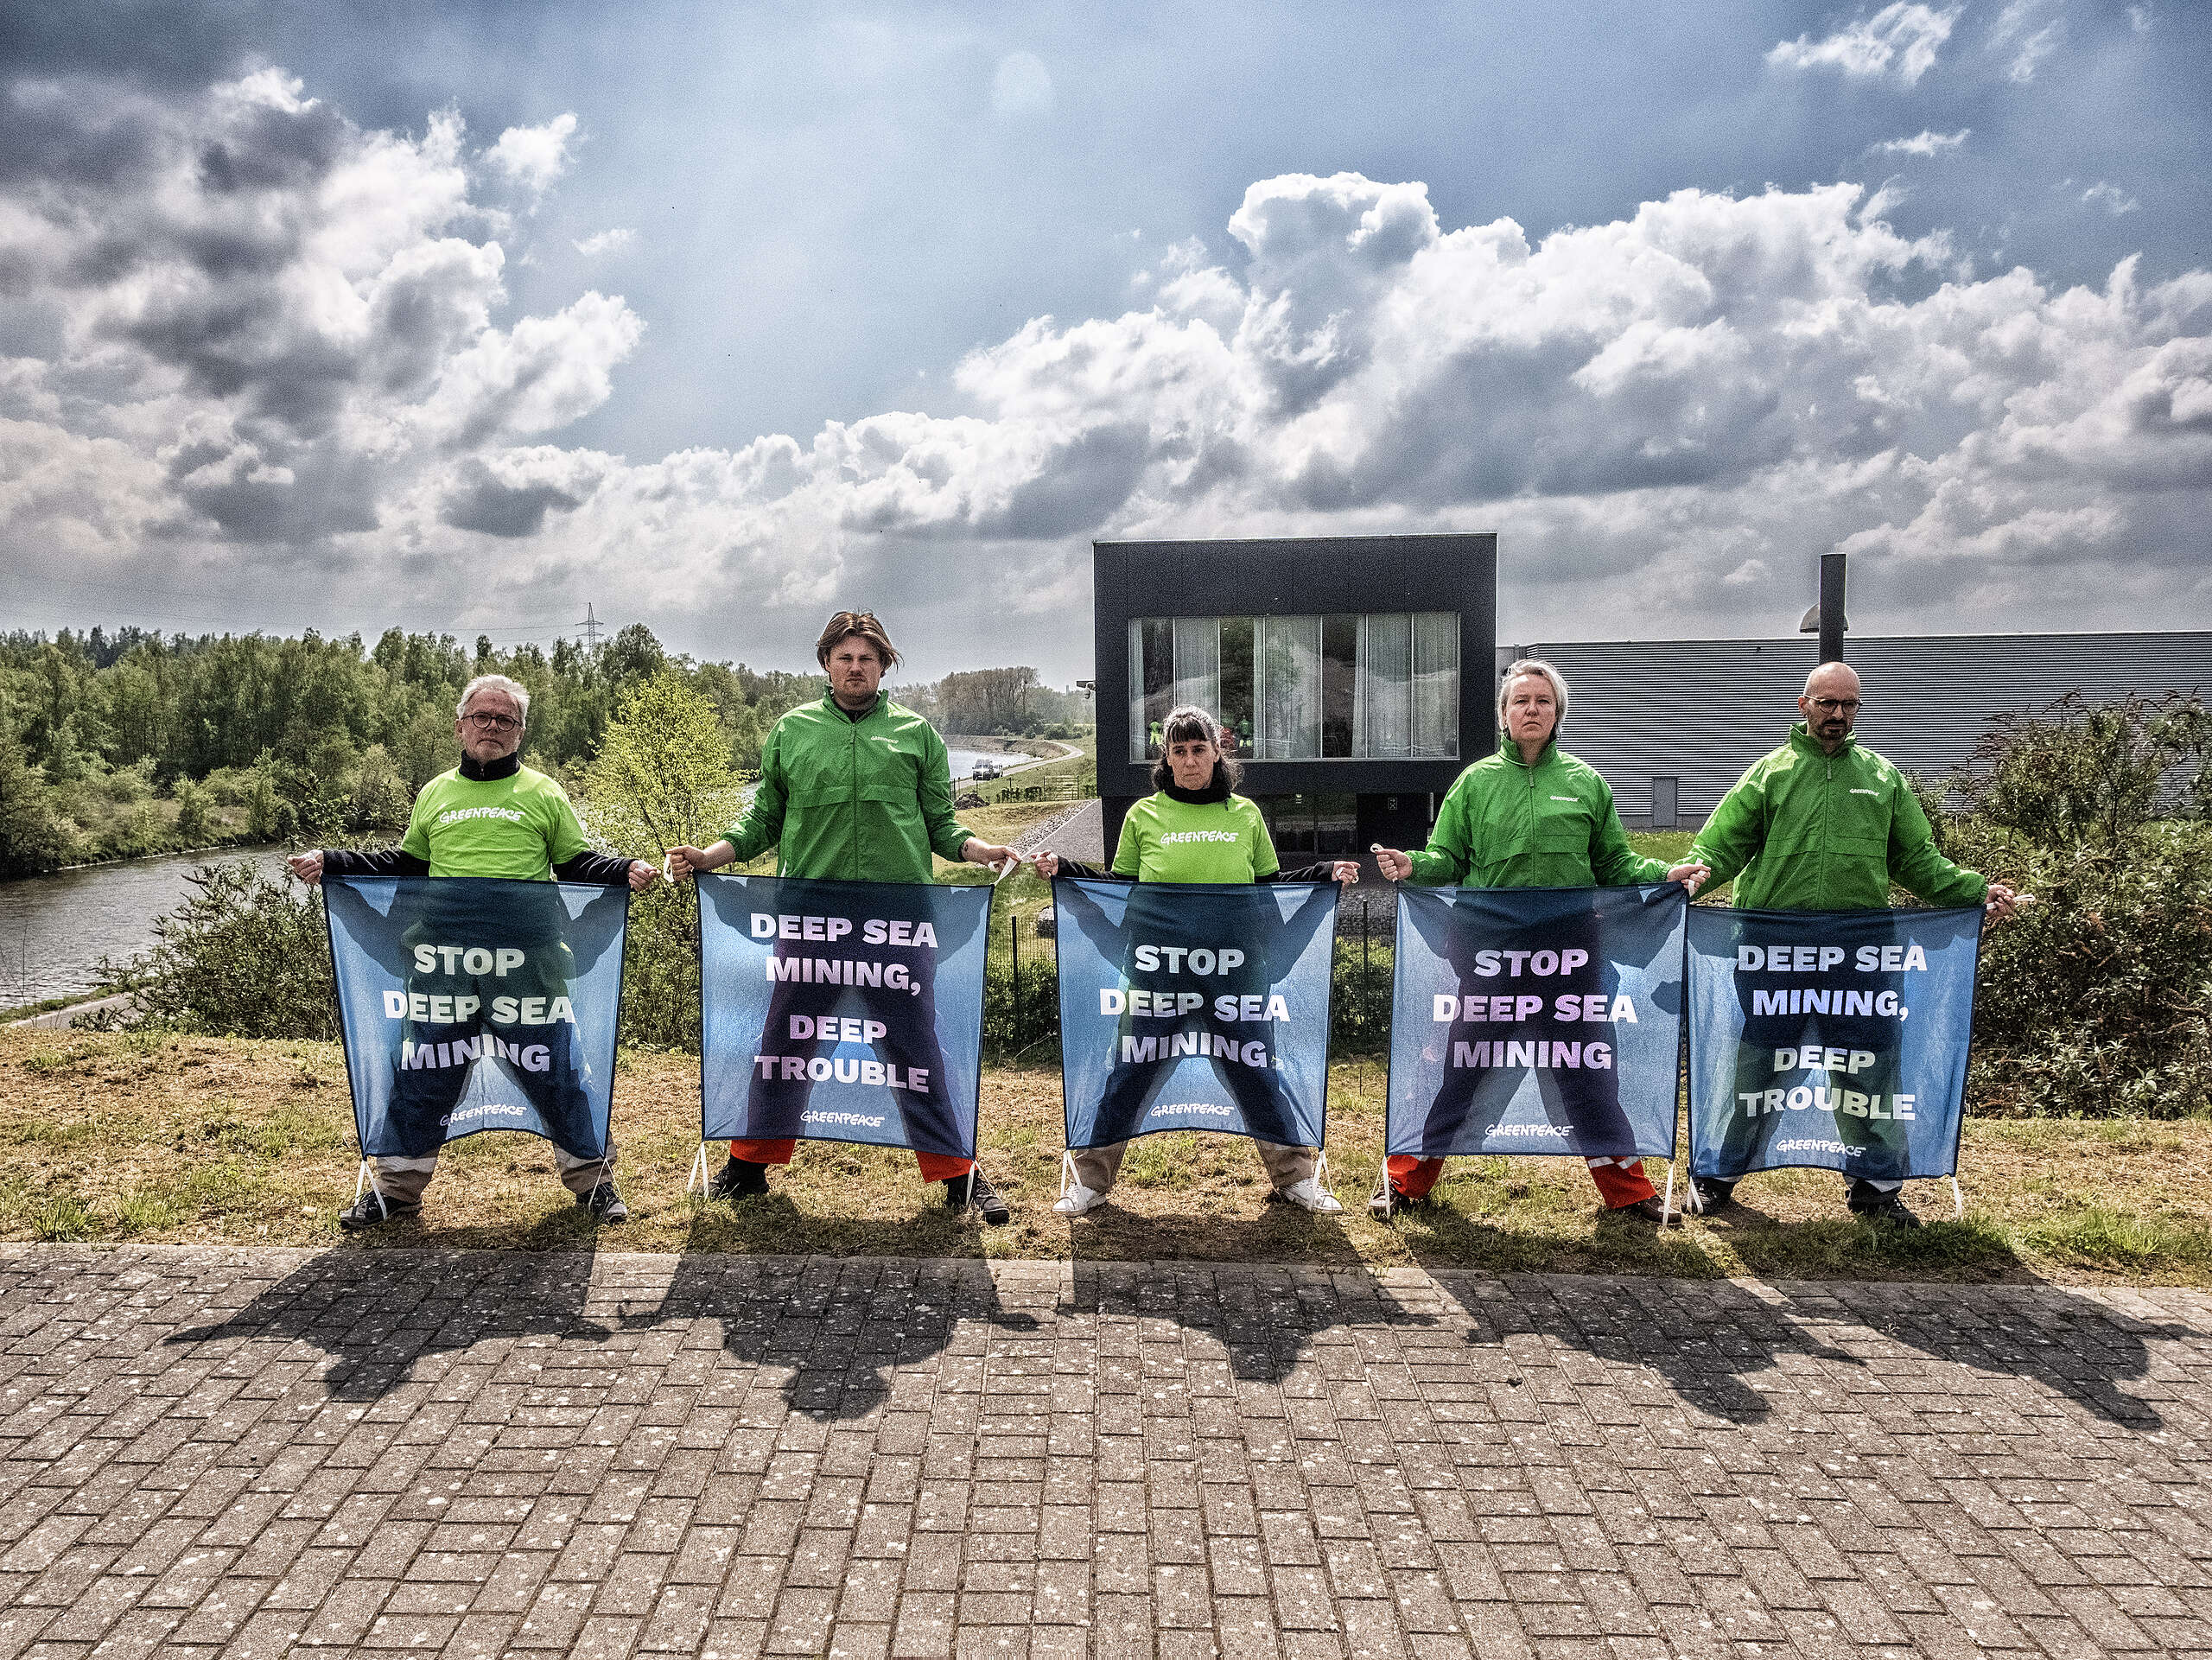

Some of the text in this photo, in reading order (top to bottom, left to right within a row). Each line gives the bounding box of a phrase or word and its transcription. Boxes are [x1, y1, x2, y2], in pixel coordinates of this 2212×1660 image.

[440, 807, 524, 823] GREENPEACE
[1160, 830, 1237, 843] GREENPEACE
[750, 913, 938, 947] DEEP SEA
[414, 944, 523, 976] STOP
[1135, 945, 1243, 974] STOP
[1473, 949, 1587, 976] STOP
[1738, 945, 1926, 970] DEEP SEA
[766, 957, 919, 995] MINING,
[383, 992, 573, 1023] DEEP SEA
[1100, 989, 1289, 1021] DEEP SEA
[1433, 995, 1637, 1021] DEEP SEA
[1752, 989, 1908, 1021] MINING,
[789, 1015, 885, 1042] DEEP
[401, 1035, 549, 1071] MINING
[1122, 1032, 1266, 1066] MINING
[1452, 1041, 1611, 1069] MINING
[1773, 1046, 1874, 1073] DEEP
[754, 1056, 928, 1092] TROUBLE
[440, 1105, 525, 1126] GREENPEACE
[1151, 1103, 1233, 1116] GREENPEACE
[1738, 1087, 1915, 1119] TROUBLE
[800, 1110, 884, 1127] GREENPEACE
[1485, 1123, 1573, 1137] GREENPEACE
[1777, 1138, 1866, 1156] GREENPEACE
